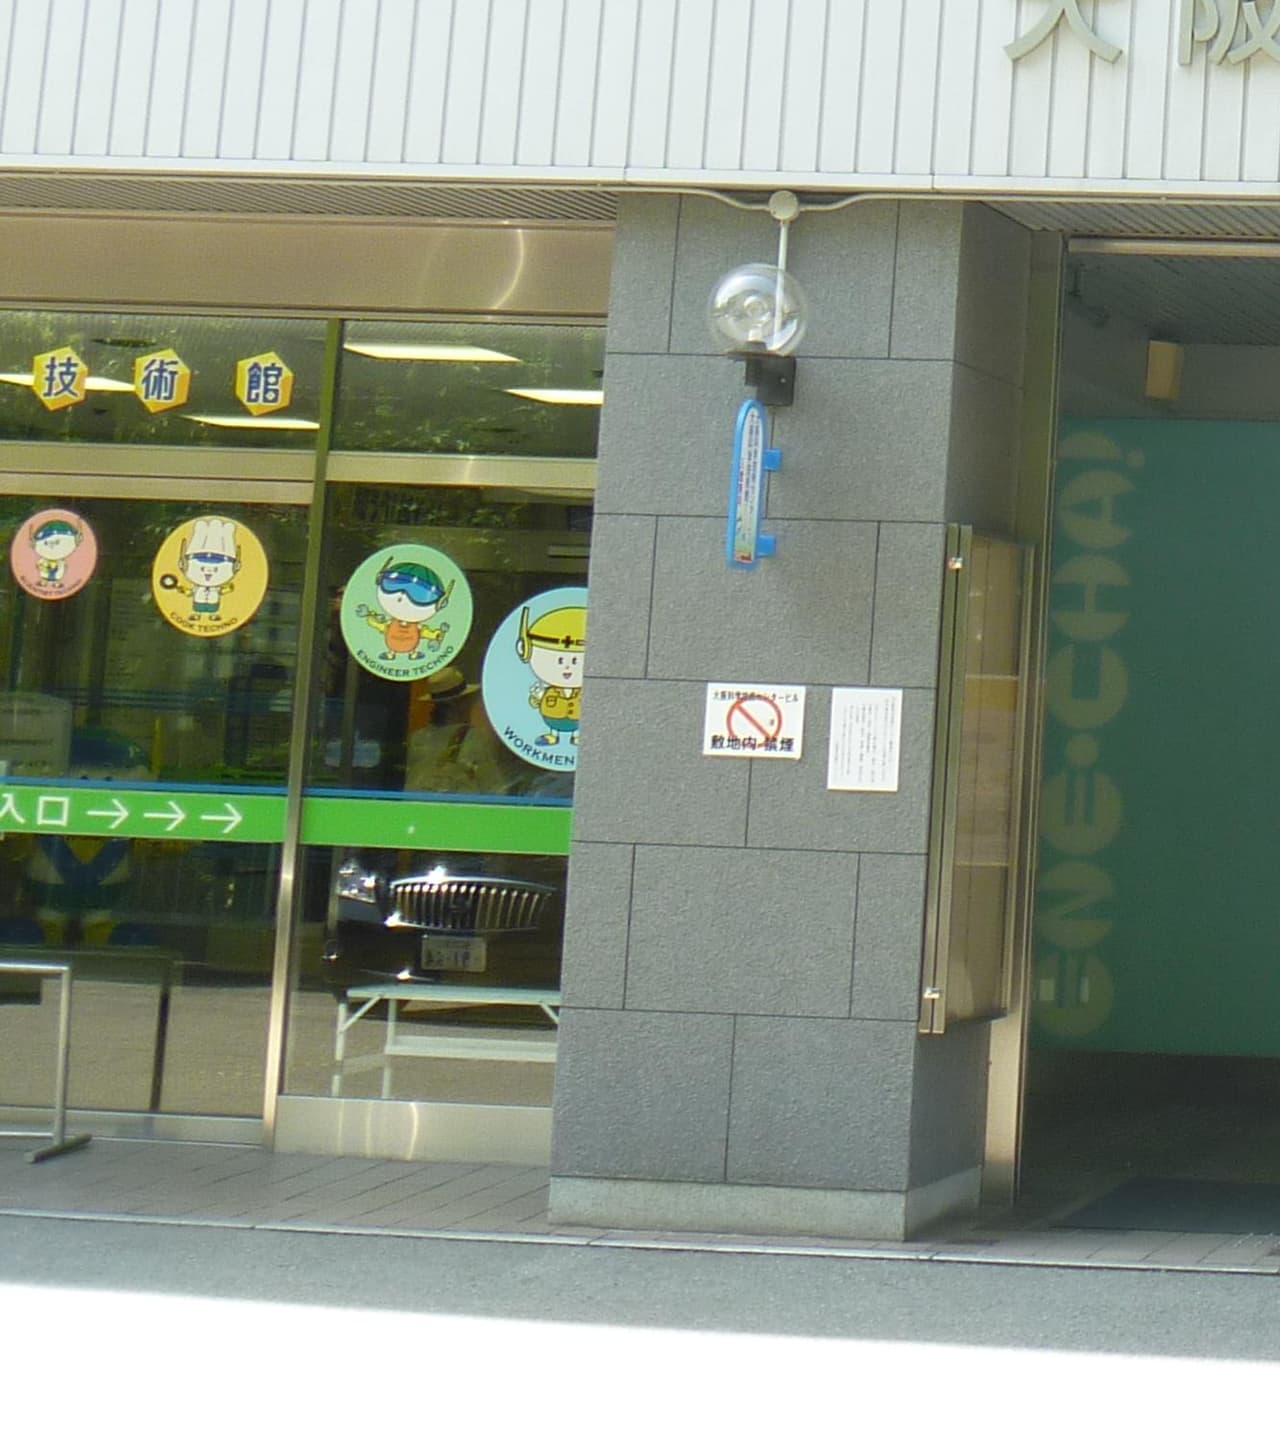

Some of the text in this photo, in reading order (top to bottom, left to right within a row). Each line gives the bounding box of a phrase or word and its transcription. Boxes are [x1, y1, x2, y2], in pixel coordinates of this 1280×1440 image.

[43, 356, 283, 404] 技術館
[170, 611, 195, 630] COOK
[356, 645, 455, 677] ENGINEER TECHNO
[503, 725, 576, 766] WORKMEN
[0, 792, 71, 827] 入口
